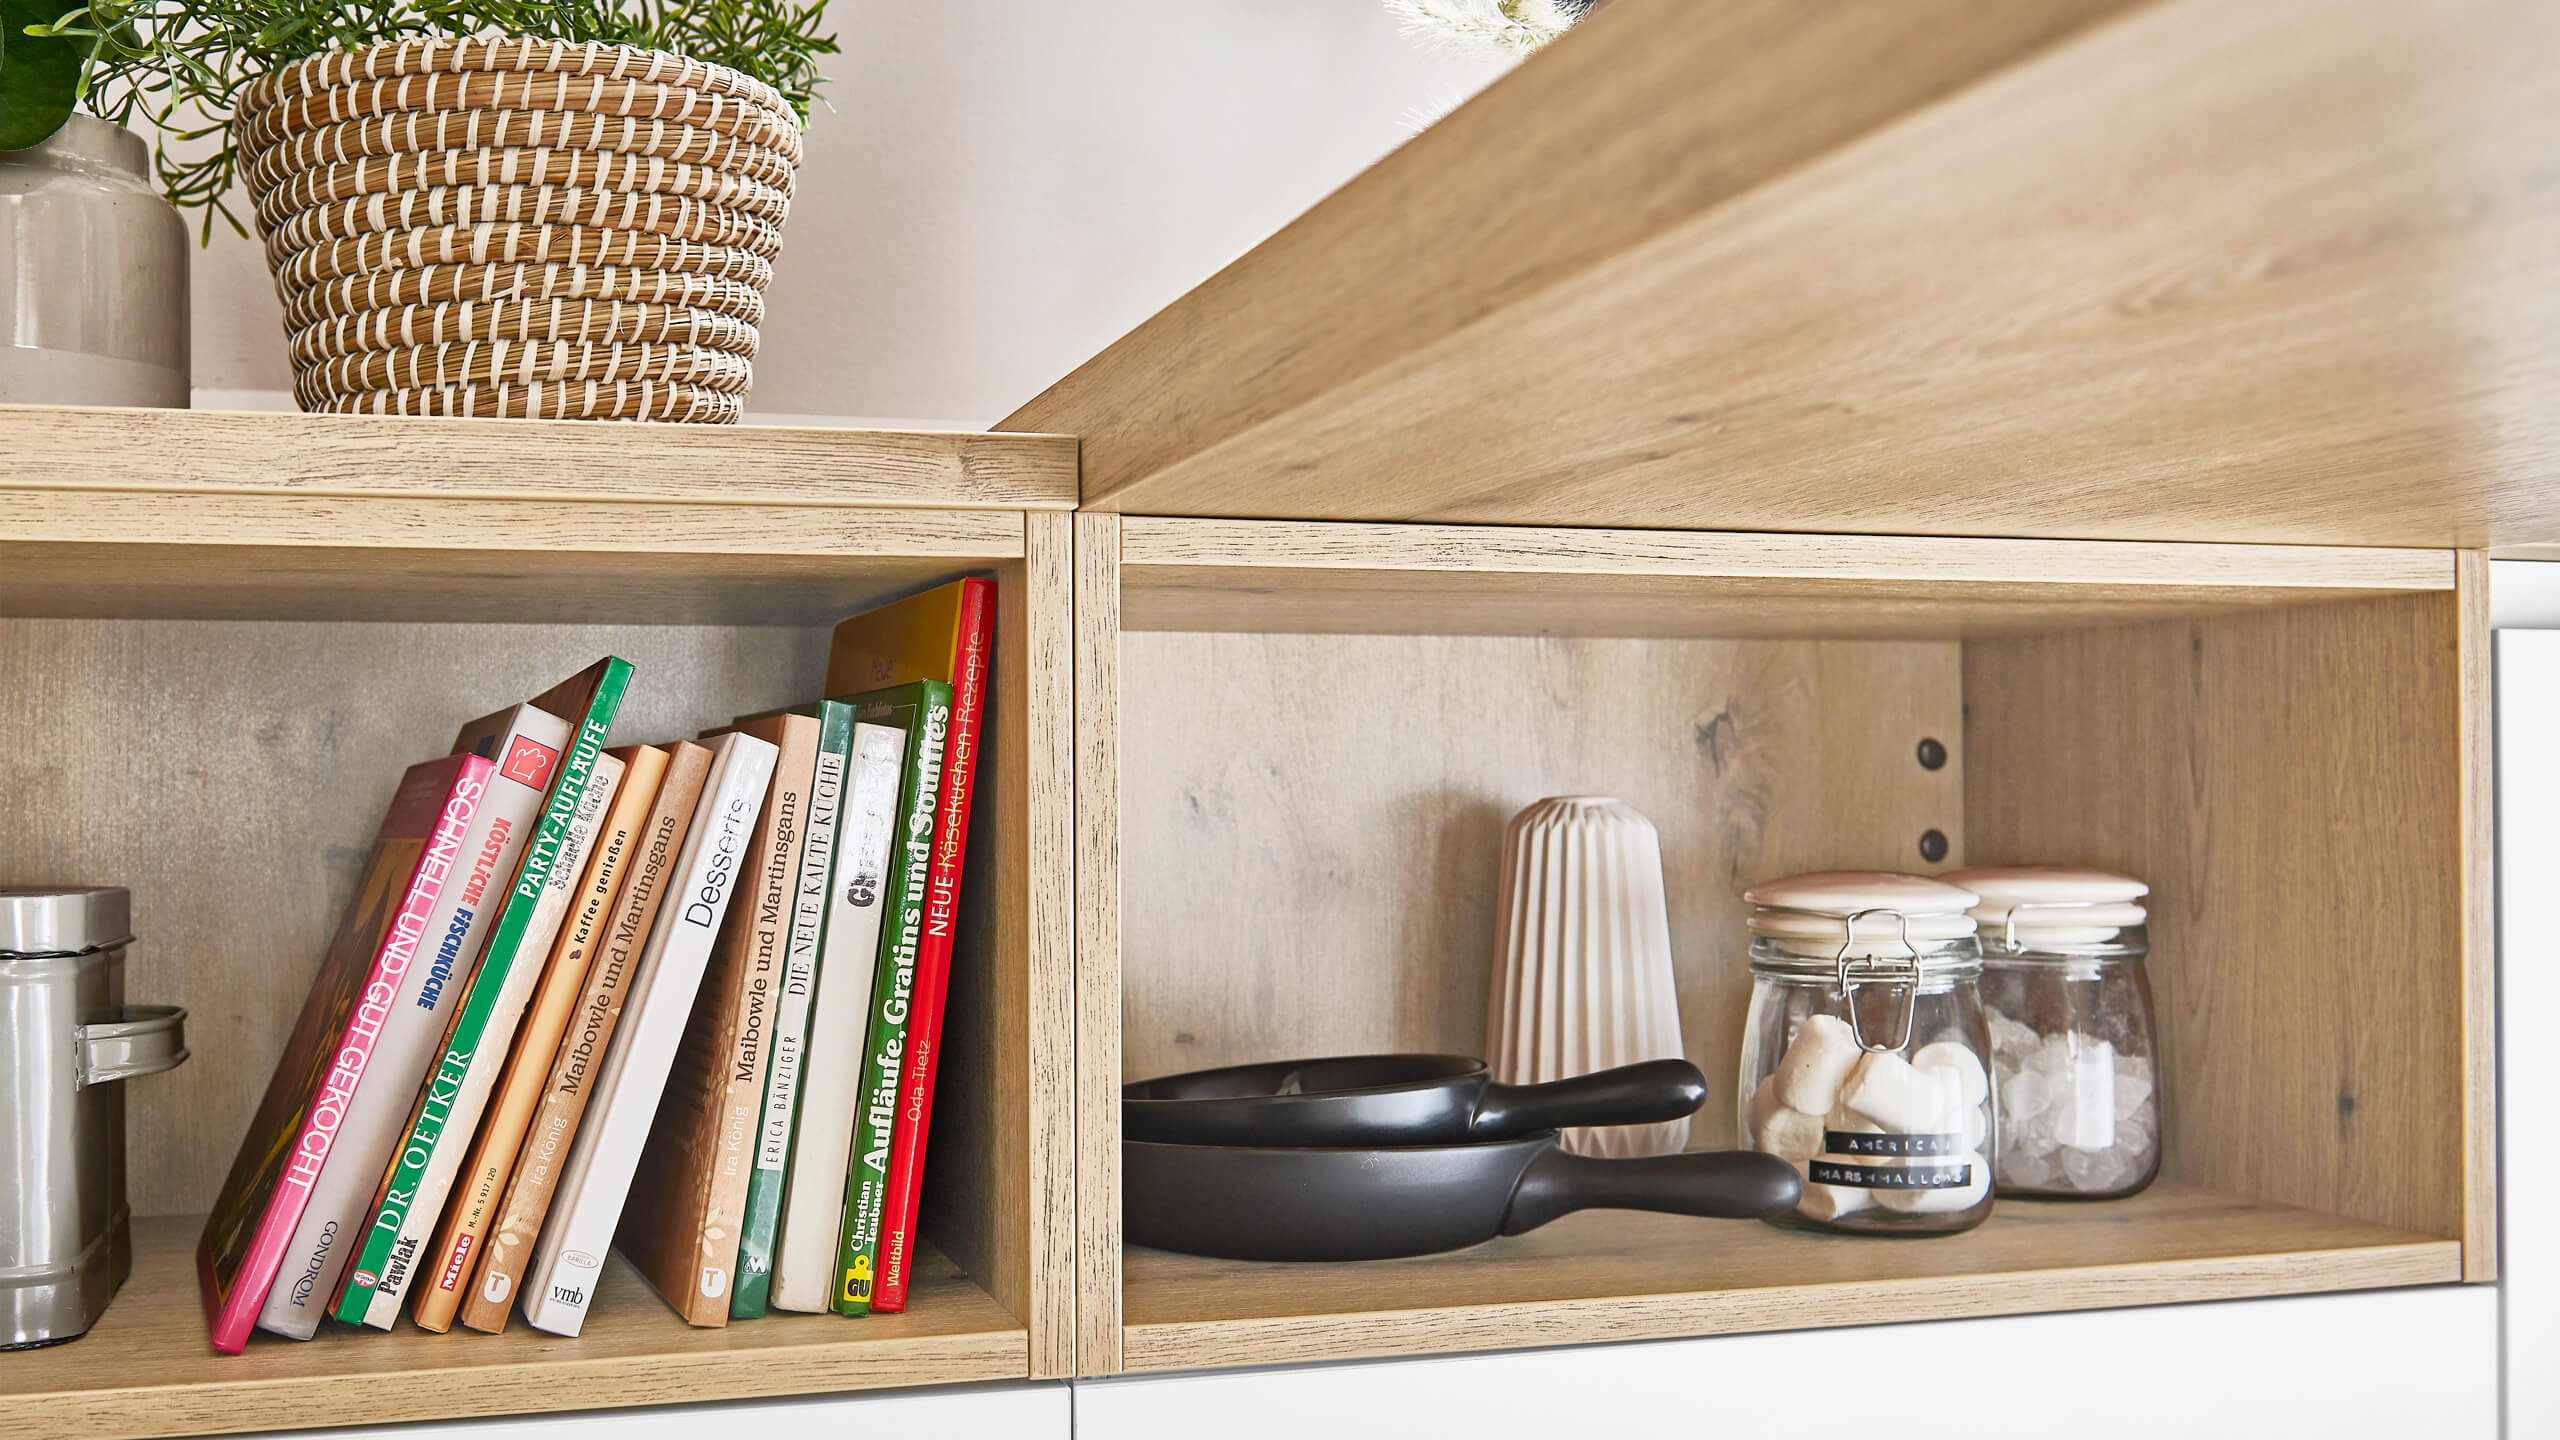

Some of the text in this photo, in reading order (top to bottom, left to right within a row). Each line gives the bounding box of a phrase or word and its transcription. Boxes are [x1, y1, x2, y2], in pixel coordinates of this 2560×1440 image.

[518, 719, 606, 899] PARTY-AUFLÄUFE
[928, 631, 984, 937] NEUE Käsekuchen Rezepte
[407, 776, 481, 901] SCHNELL
[684, 798, 752, 929] Desserts
[788, 757, 840, 996] DIE NEUE KALTE KÜCHE
[907, 841, 930, 903] und
[574, 830, 627, 943] Kaffee genießen
[380, 910, 426, 975] UND
[560, 816, 676, 1096] Maibowle und Martinsgans
[736, 791, 798, 1083] Maibowle und Martinsgans
[884, 908, 920, 1025] Gratins
[349, 980, 393, 1044] GUT
[287, 1046, 365, 1194] GEKOCHT
[766, 1036, 797, 1163] ERICA BÄNZIGER
[864, 1032, 907, 1174] Aufläufe,
[907, 1040, 930, 1122] Oda Tietz
[375, 1049, 472, 1235] DR. OETKER
[480, 1184, 491, 1197] 917
[487, 1167, 497, 1181] 120
[530, 1117, 567, 1185] Ira König
[725, 1105, 750, 1177] Ira König
[850, 1180, 872, 1252] Christian
[865, 1181, 884, 1244] Teubner
[291, 1221, 338, 1308] GONDROM
[377, 1236, 419, 1296] Pawlak
[442, 1236, 471, 1290] Miele
[554, 1286, 584, 1305] vmb
[848, 1278, 870, 1297] GU
[886, 1231, 905, 1287] Weltbild
